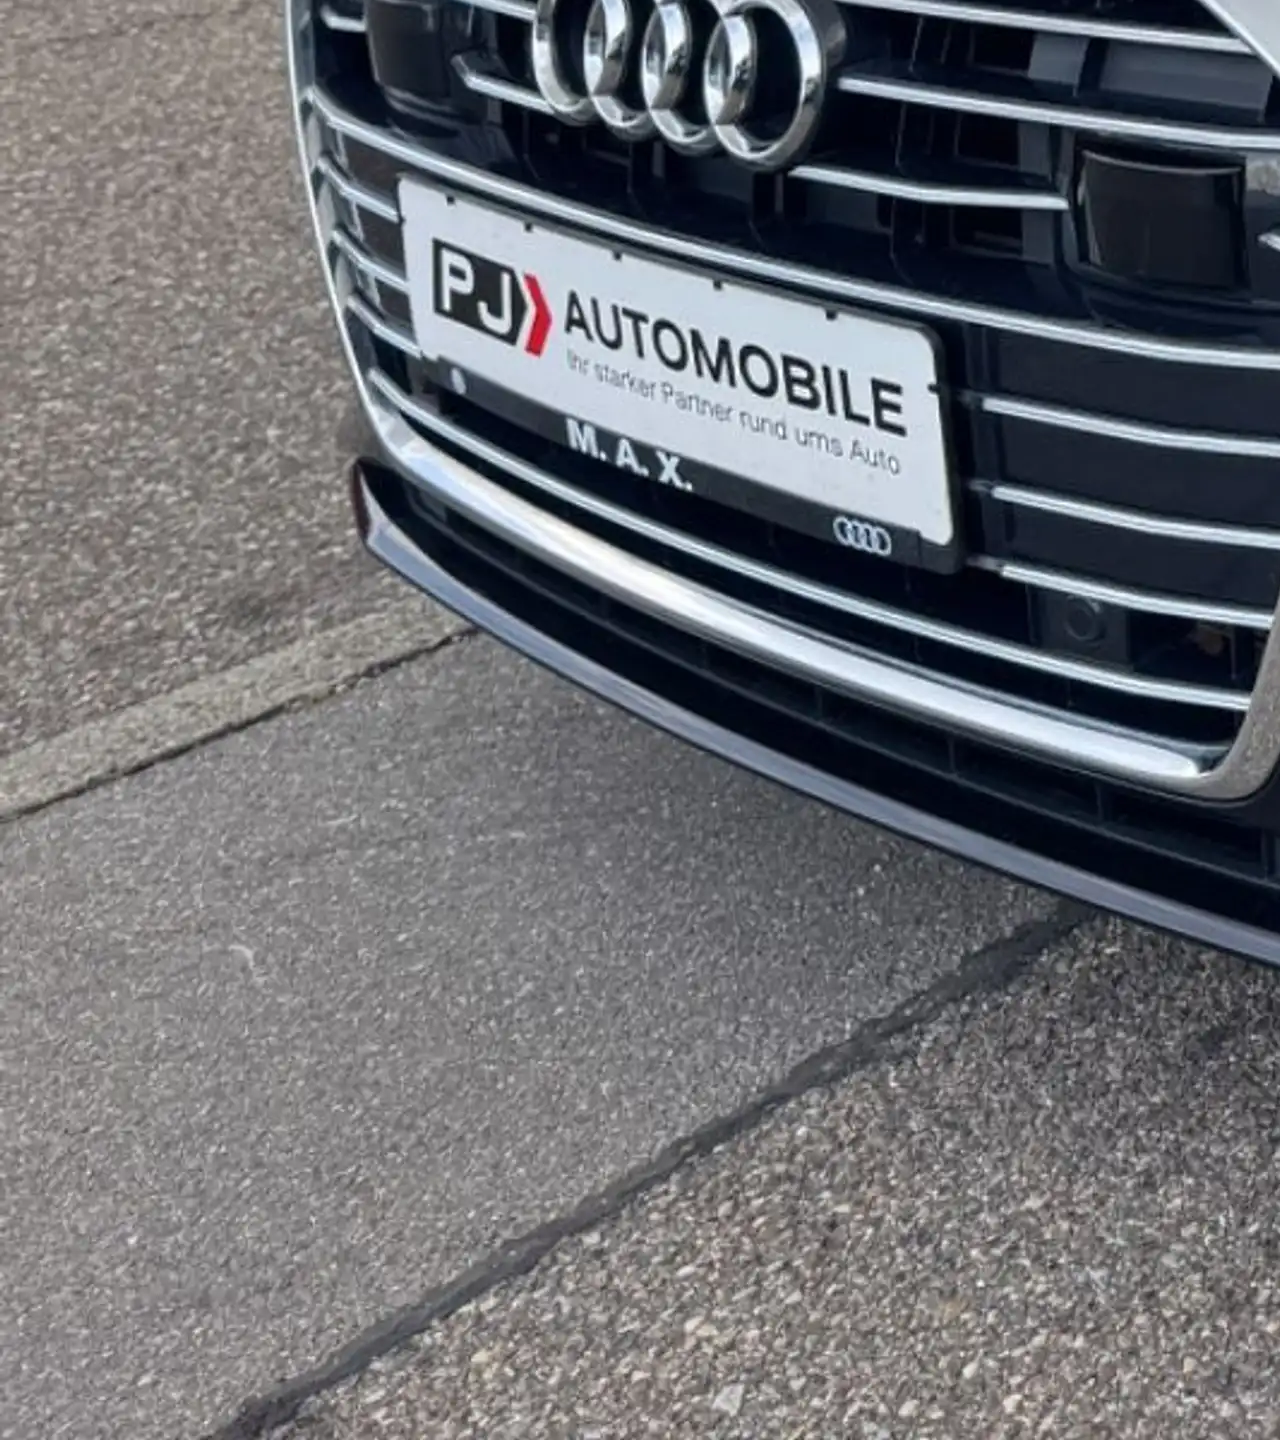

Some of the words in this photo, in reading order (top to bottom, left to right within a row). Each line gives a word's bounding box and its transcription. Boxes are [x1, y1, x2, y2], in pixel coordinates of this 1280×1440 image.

[440, 246, 513, 335] PJ
[563, 288, 908, 438] AUTOMOBILE
[566, 348, 589, 376] Ihr
[594, 361, 657, 401] starker
[660, 380, 733, 423] Partner
[739, 411, 788, 441] rund
[794, 426, 844, 458] ums
[849, 438, 901, 476] Auto
